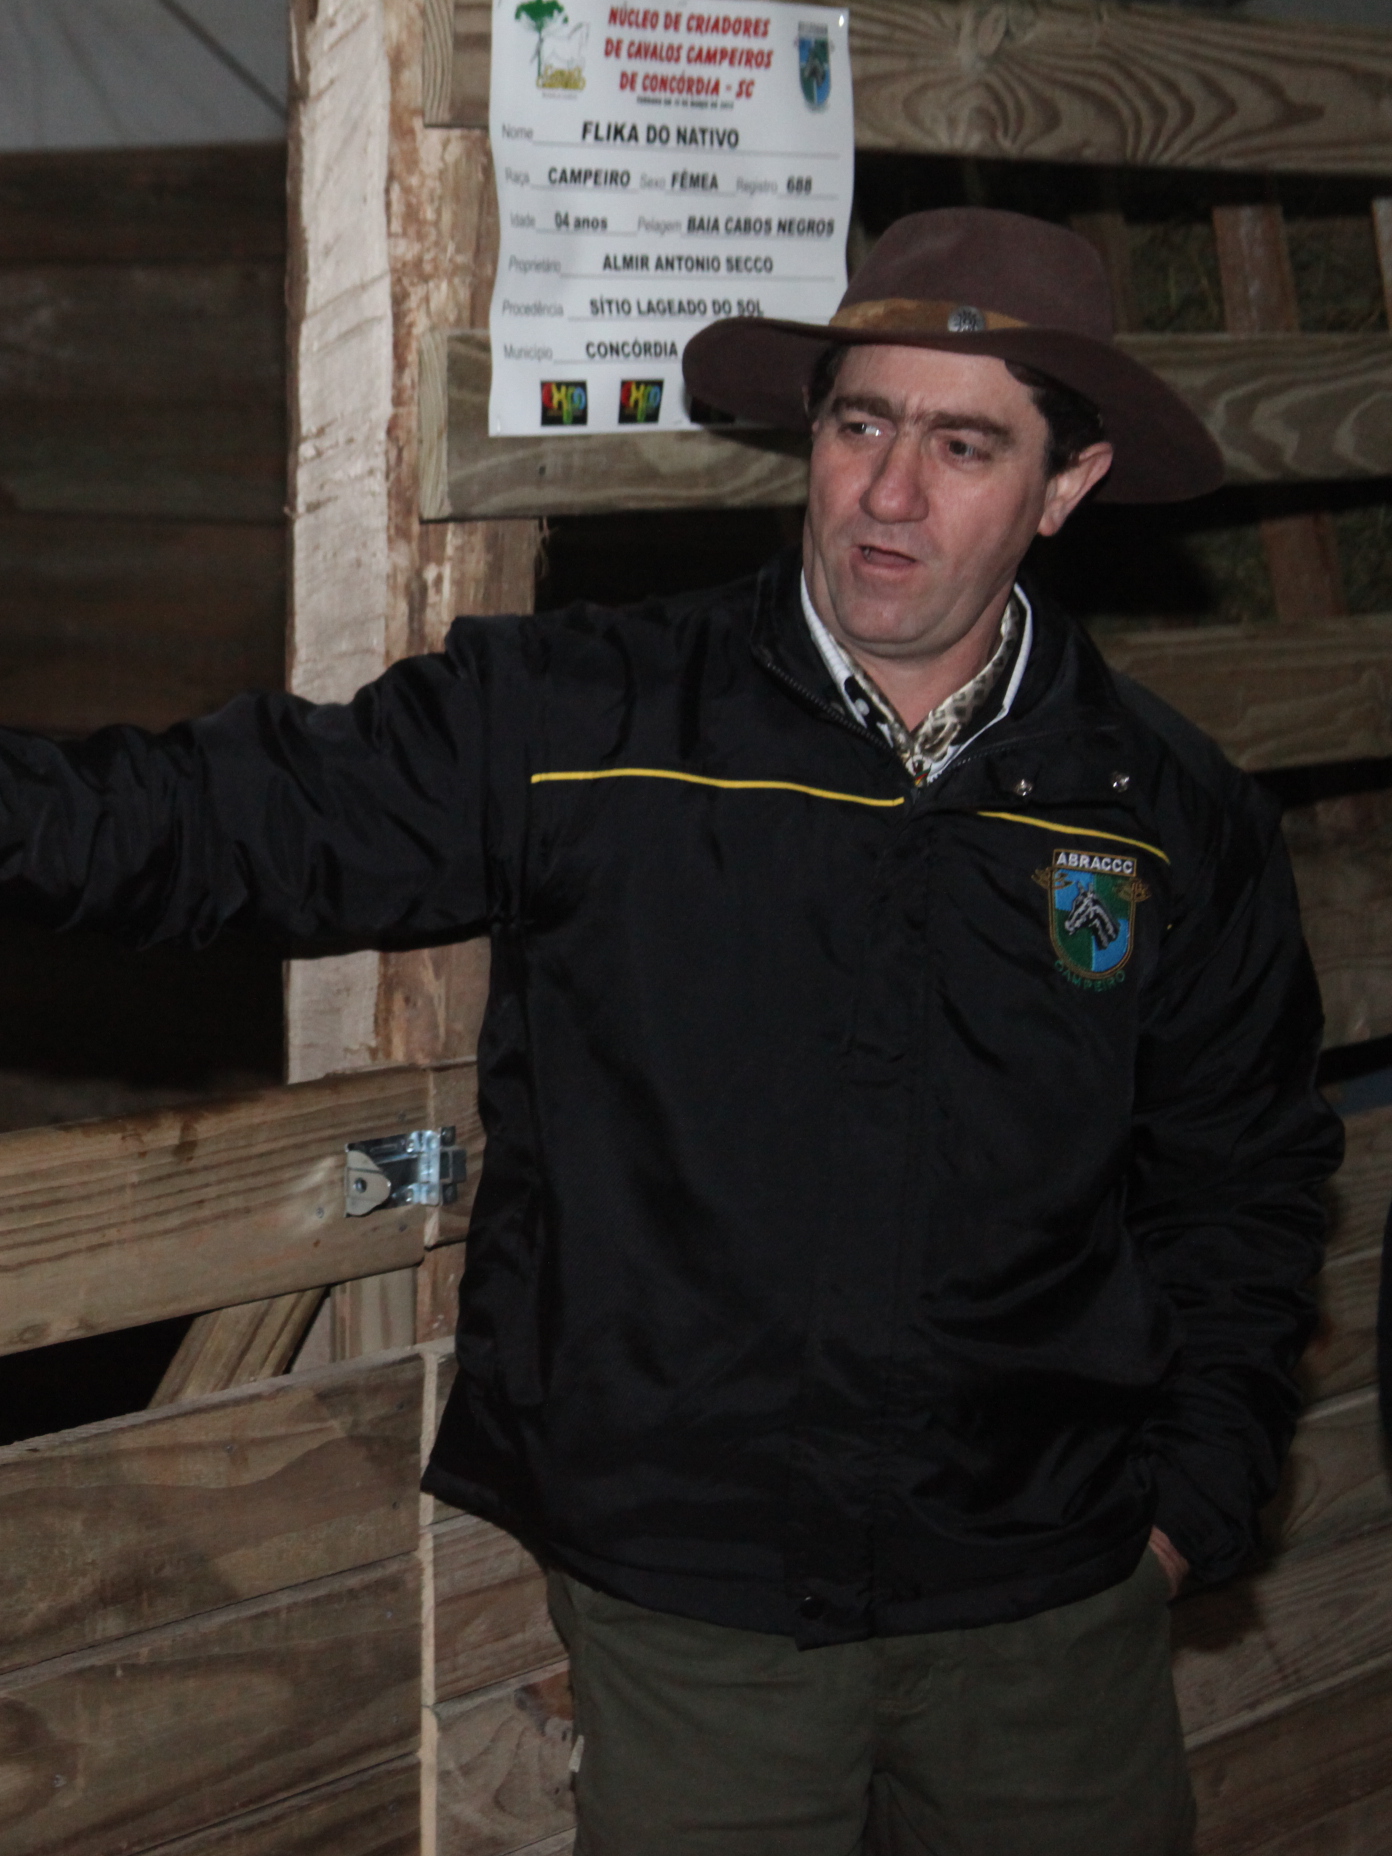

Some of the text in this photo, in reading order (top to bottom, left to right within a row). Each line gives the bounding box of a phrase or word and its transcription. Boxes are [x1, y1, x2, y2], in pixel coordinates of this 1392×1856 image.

[608, 2, 659, 30] NÚCLEO
[664, 11, 682, 32] DE
[687, 13, 770, 38] CRIADORES
[604, 37, 773, 69] DE CAVALOS CAMPEIROS
[619, 70, 638, 91] DE
[642, 69, 720, 96] CONCÓRDIA
[736, 79, 755, 99] SC
[502, 121, 739, 149] Nome FLIKA DO NATIVO
[548, 166, 631, 188] CAMPEIRO
[671, 168, 719, 190] FÊMEA
[555, 210, 570, 229] 04
[574, 216, 608, 230] anos
[687, 215, 720, 233] BAIA
[724, 216, 772, 235] CABOS
[777, 217, 835, 237] NEGROS
[603, 254, 649, 271] ALMIR
[655, 255, 721, 273] ANTONIO
[726, 256, 774, 274] SECCO
[589, 294, 632, 316] SÍTIO
[712, 299, 732, 316] DO
[737, 299, 764, 317] SOL
[585, 337, 678, 359] CONCÓRDIA
[1056, 852, 1133, 874] ABRACCC
